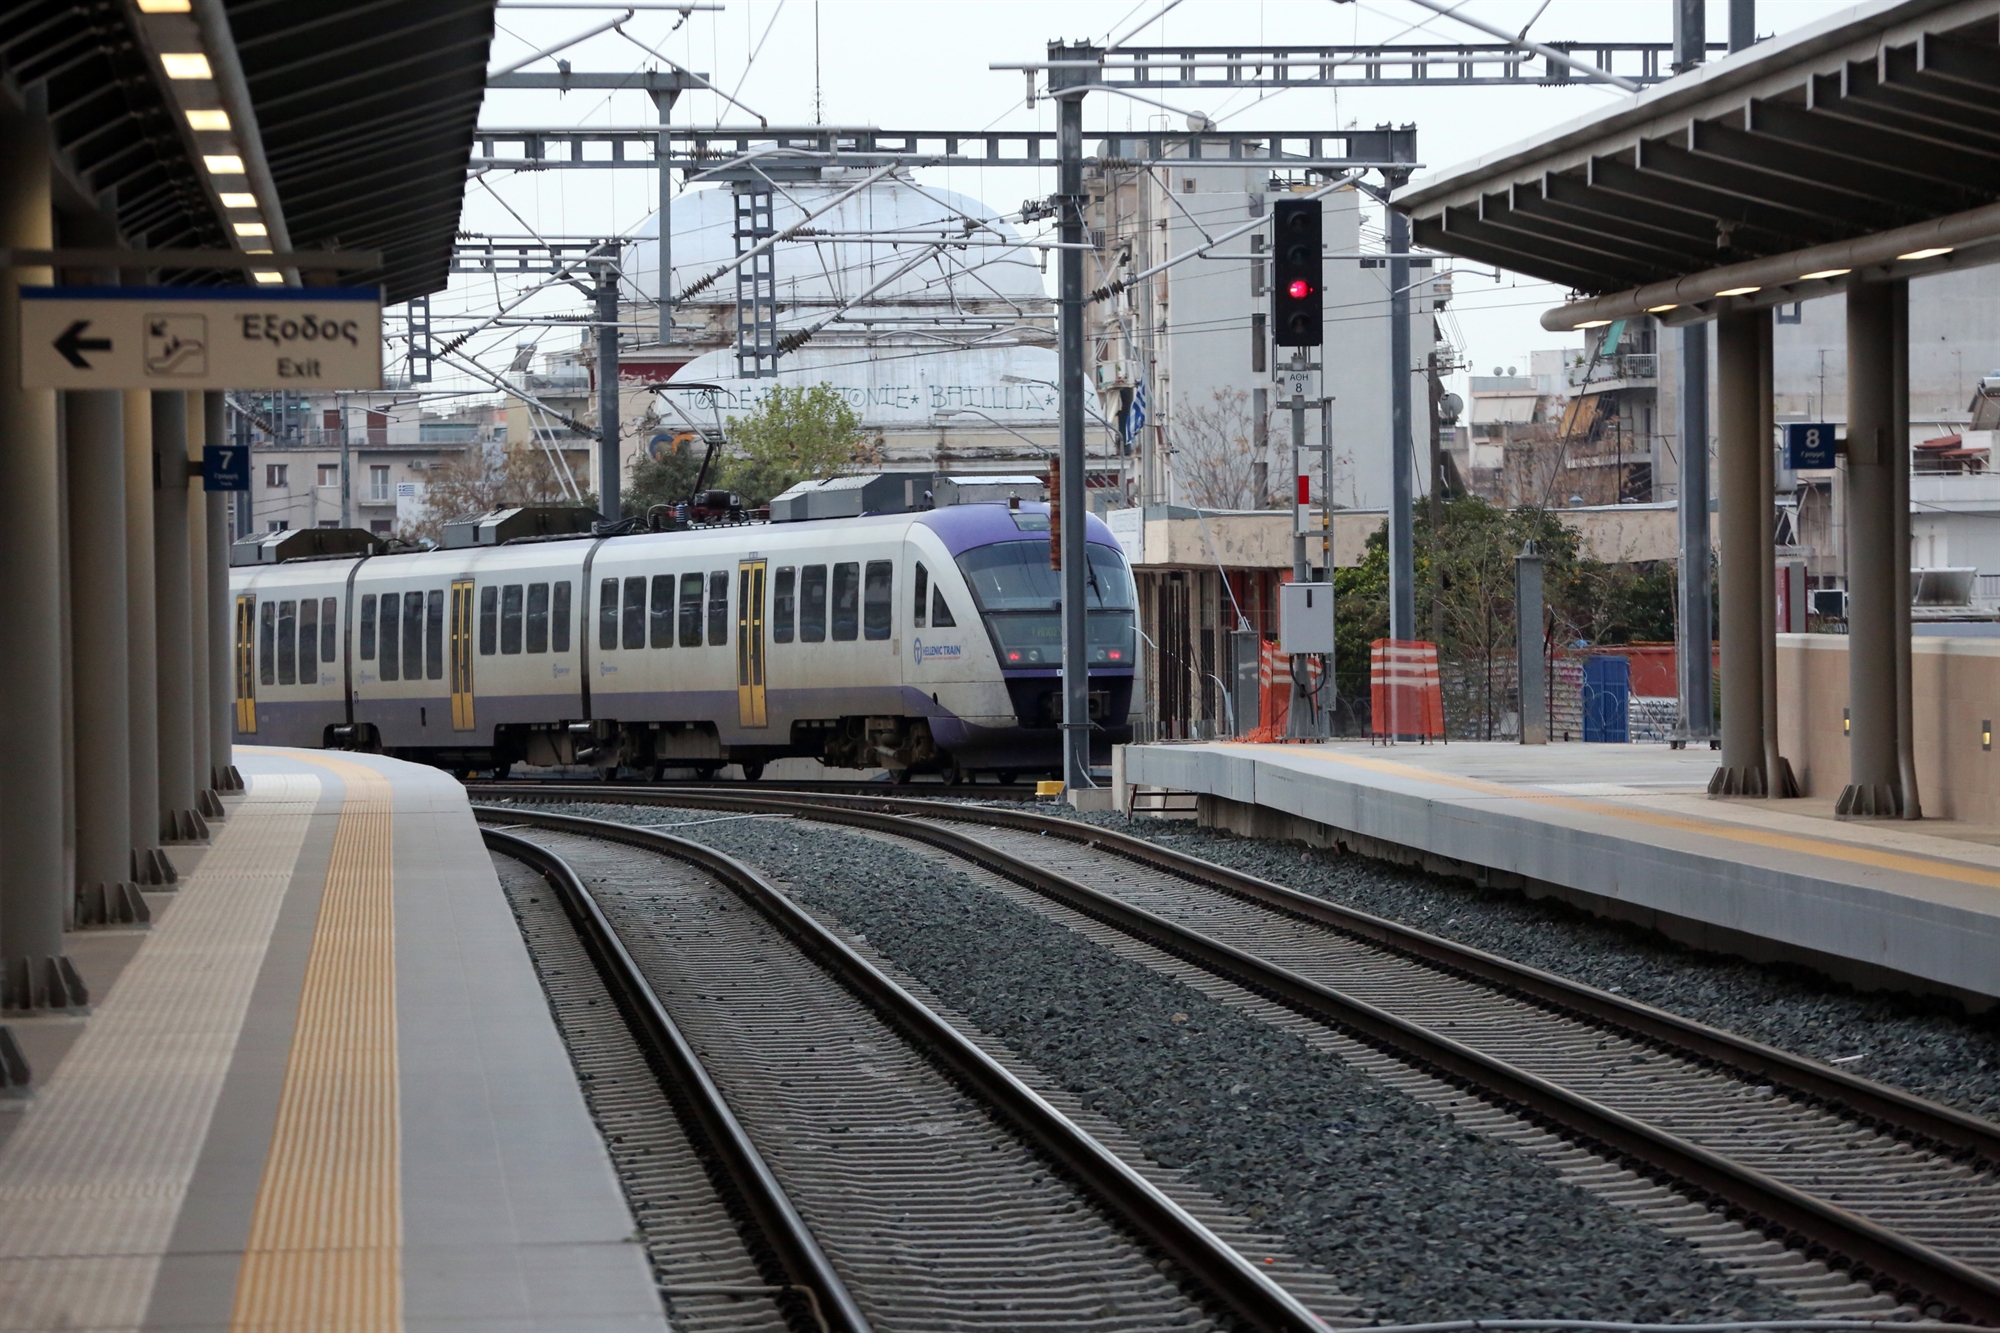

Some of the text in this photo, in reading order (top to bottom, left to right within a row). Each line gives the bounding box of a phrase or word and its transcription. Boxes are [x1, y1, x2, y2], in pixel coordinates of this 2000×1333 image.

[235, 314, 358, 347] Έξοδος
[277, 357, 321, 379] Exit
[1295, 382, 1303, 393] 8
[1806, 429, 1820, 448] 8
[219, 451, 233, 470] 7
[943, 645, 961, 655] TRAIN
